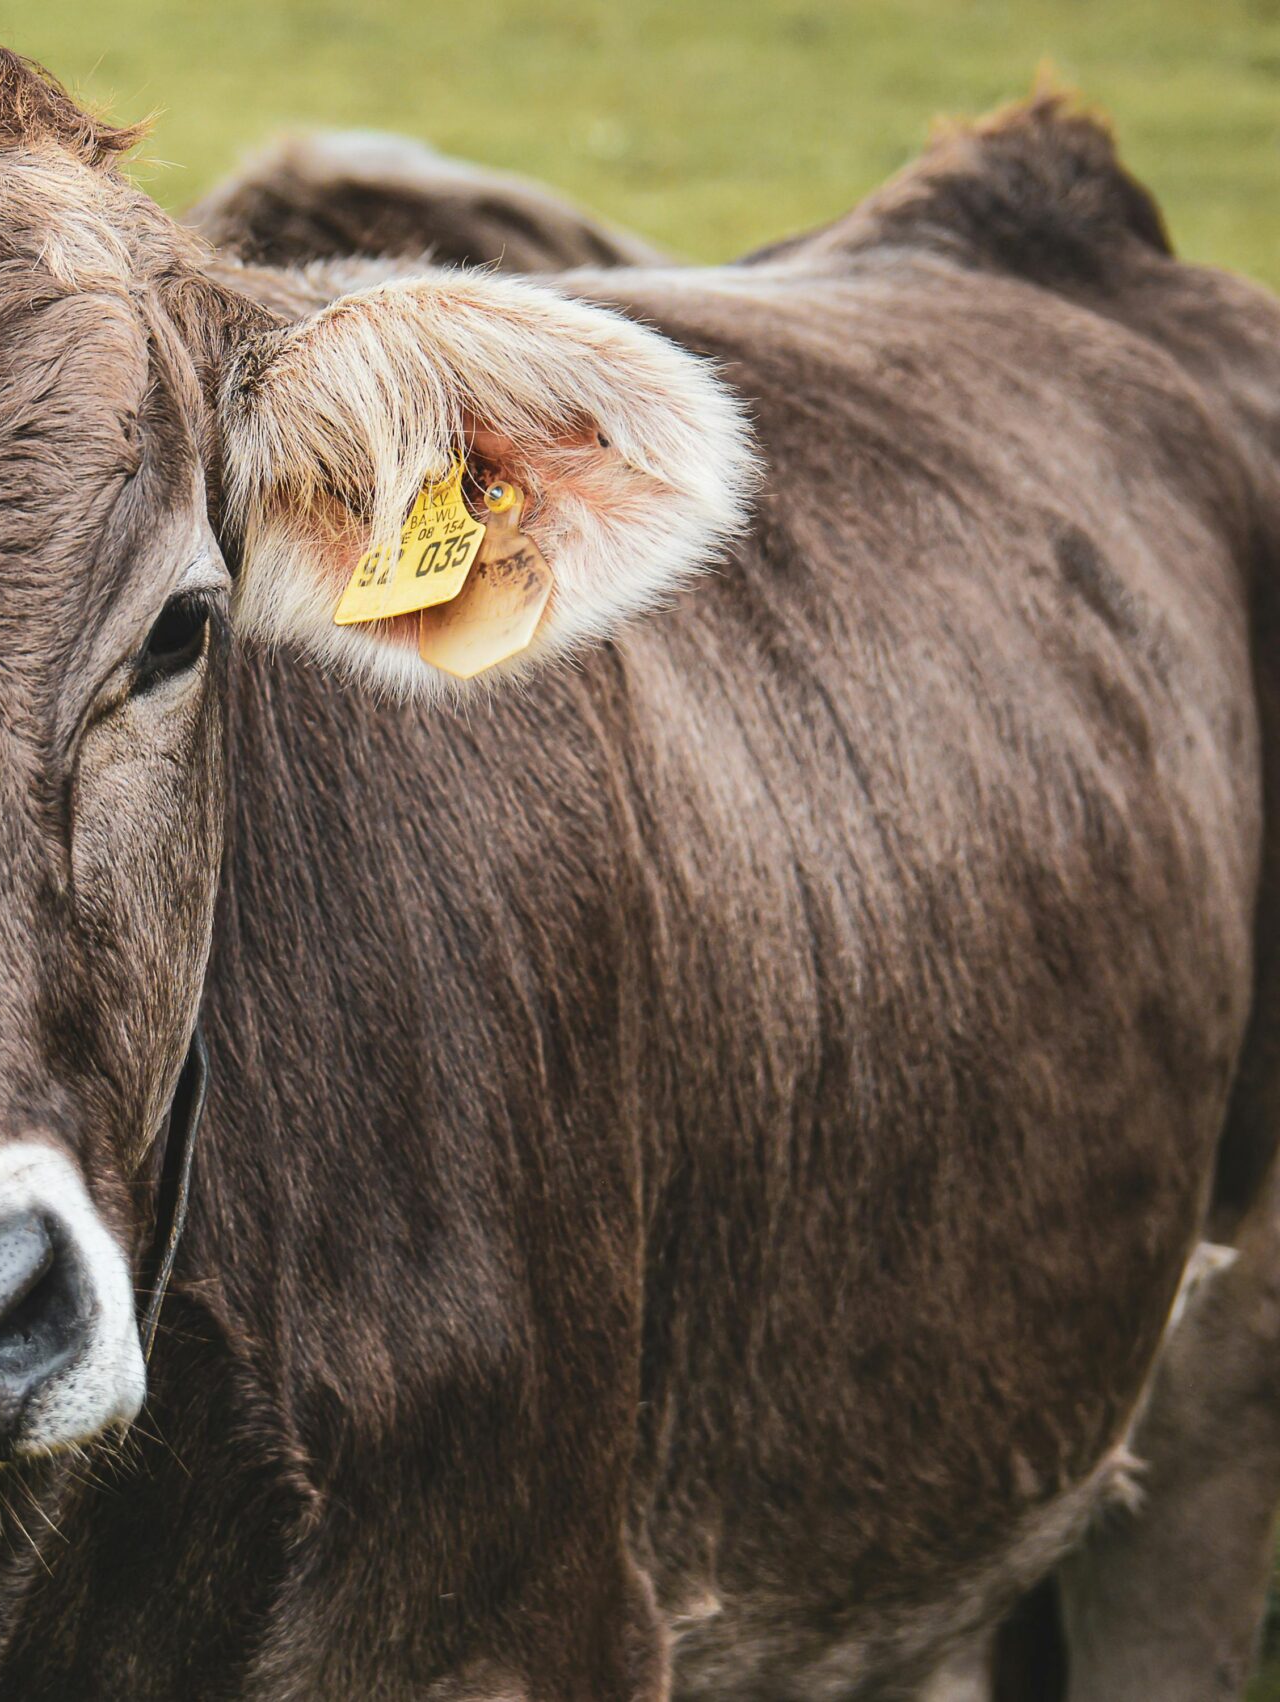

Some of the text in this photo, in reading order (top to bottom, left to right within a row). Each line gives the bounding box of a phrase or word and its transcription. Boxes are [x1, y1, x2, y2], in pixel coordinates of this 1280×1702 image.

[422, 492, 449, 511] LKV
[417, 526, 435, 541] 08
[442, 518, 466, 535] 154
[415, 528, 478, 579] 035
